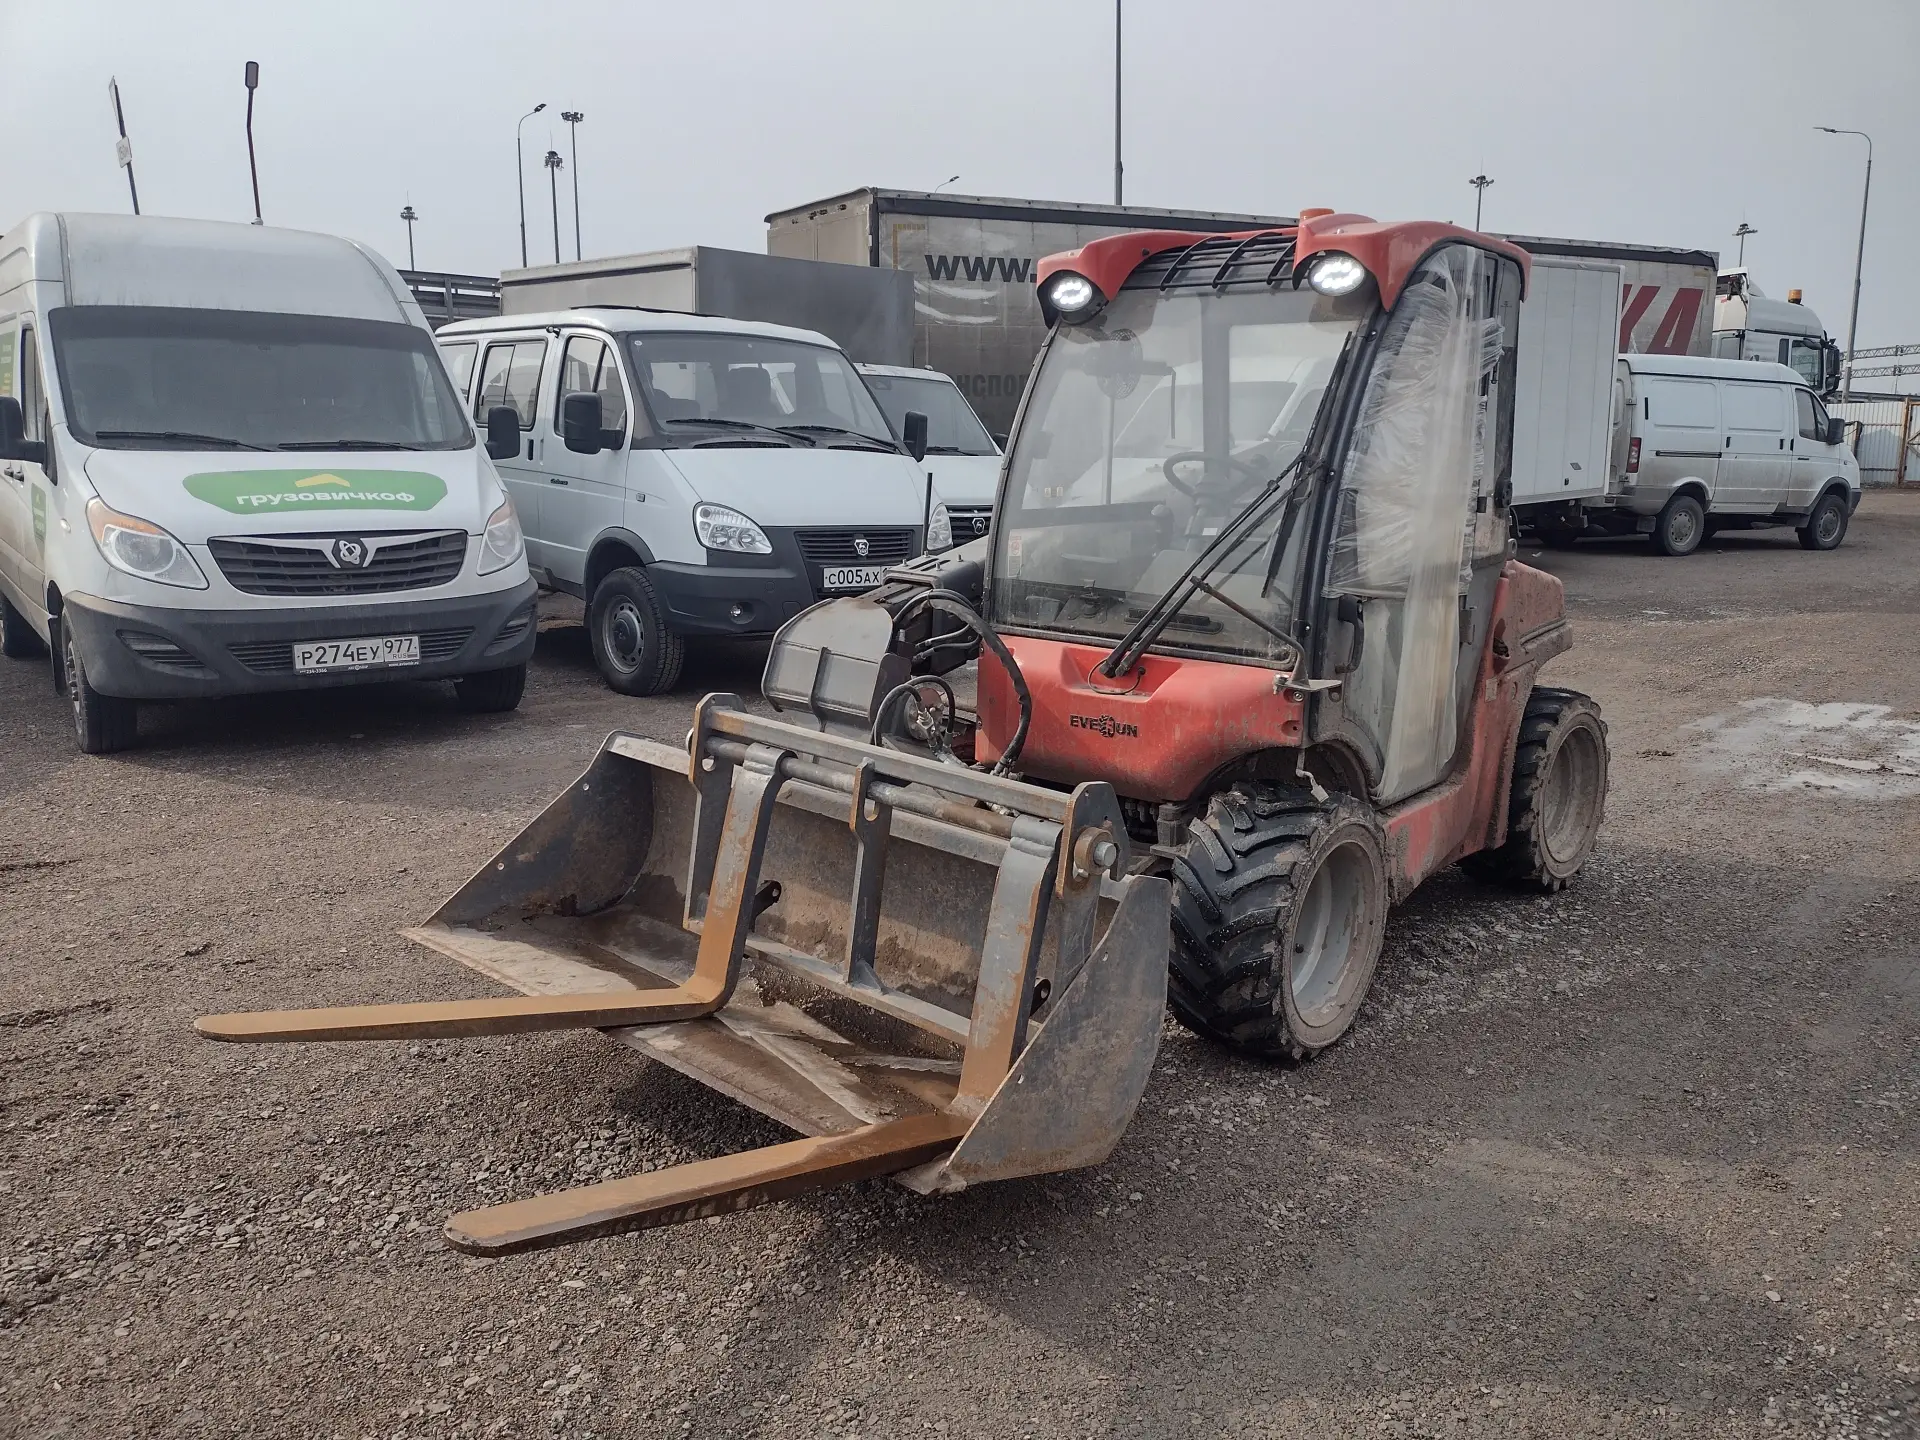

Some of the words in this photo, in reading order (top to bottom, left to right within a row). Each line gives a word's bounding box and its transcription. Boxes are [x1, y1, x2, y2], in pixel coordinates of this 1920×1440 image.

[235, 492, 416, 507] грузовичкоф
[828, 569, 880, 585] С005АХ
[301, 643, 380, 666] Р274ЕУ
[384, 638, 413, 654] 977
